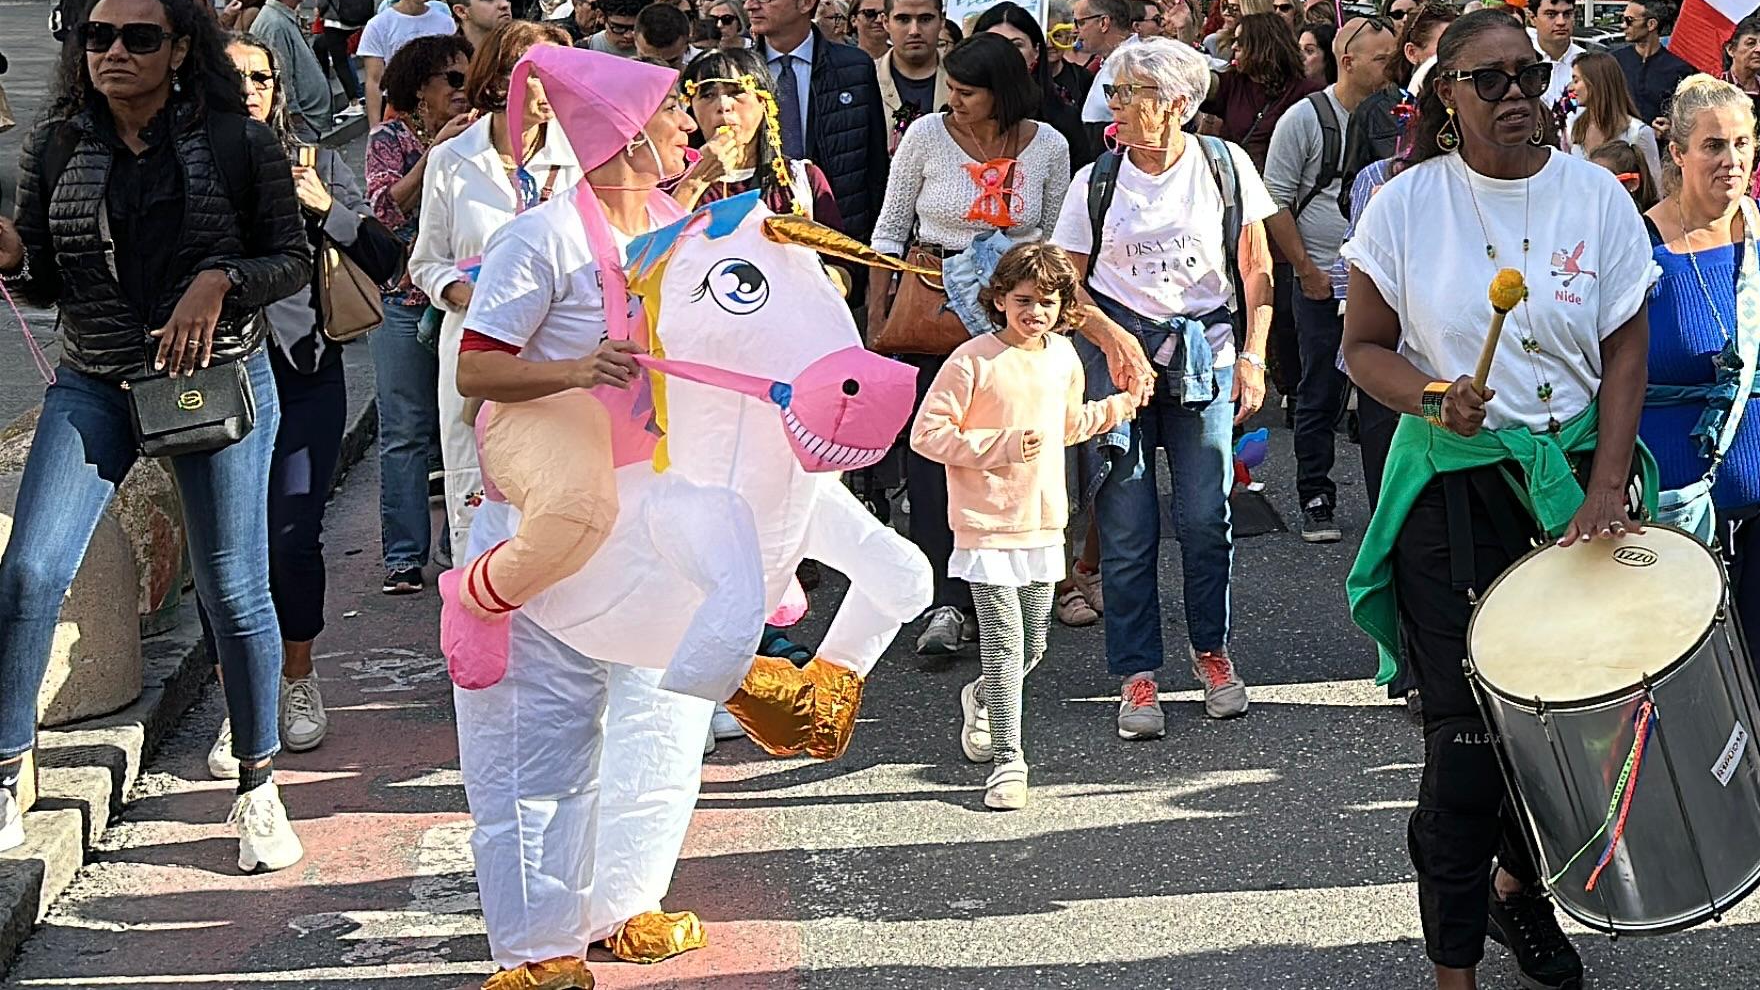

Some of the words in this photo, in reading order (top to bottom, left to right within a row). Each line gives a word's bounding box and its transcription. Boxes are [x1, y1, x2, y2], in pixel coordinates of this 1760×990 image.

[1555, 290, 1582, 305] Nide
[1617, 551, 1654, 563] IZZO
[1453, 732, 1501, 745] ALLSX
